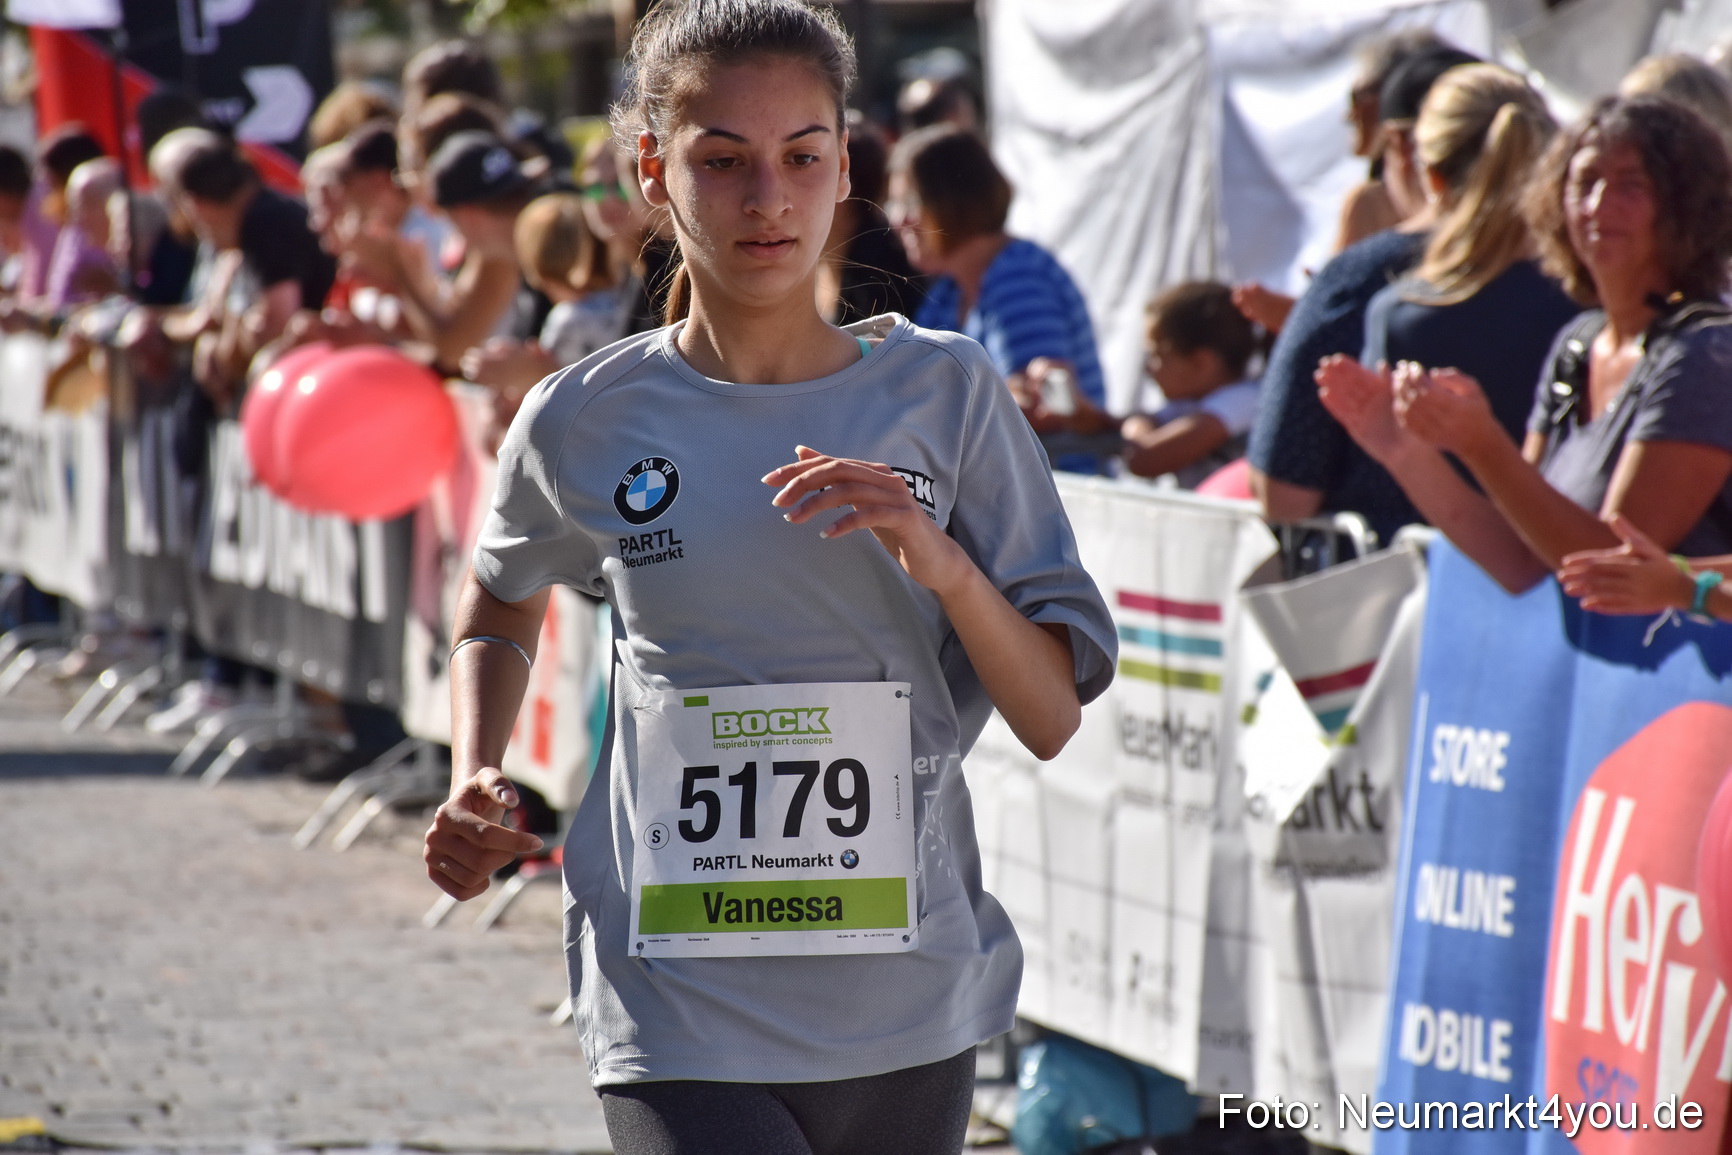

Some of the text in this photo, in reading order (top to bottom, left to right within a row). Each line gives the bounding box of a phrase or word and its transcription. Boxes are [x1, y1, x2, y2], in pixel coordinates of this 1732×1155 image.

[621, 458, 675, 486] BMW
[618, 528, 682, 556] PARTL
[622, 547, 684, 569] Neumarkt
[712, 707, 832, 739] BOCK
[713, 736, 833, 751] inspired by smart concepts
[1429, 723, 1510, 792] STORE
[678, 758, 871, 843] 5179
[651, 829, 661, 844] S
[693, 855, 747, 871] PARTL
[751, 853, 834, 869] Neumarkt
[703, 891, 844, 924] Vanessa
[1551, 787, 1732, 1118] Herv
